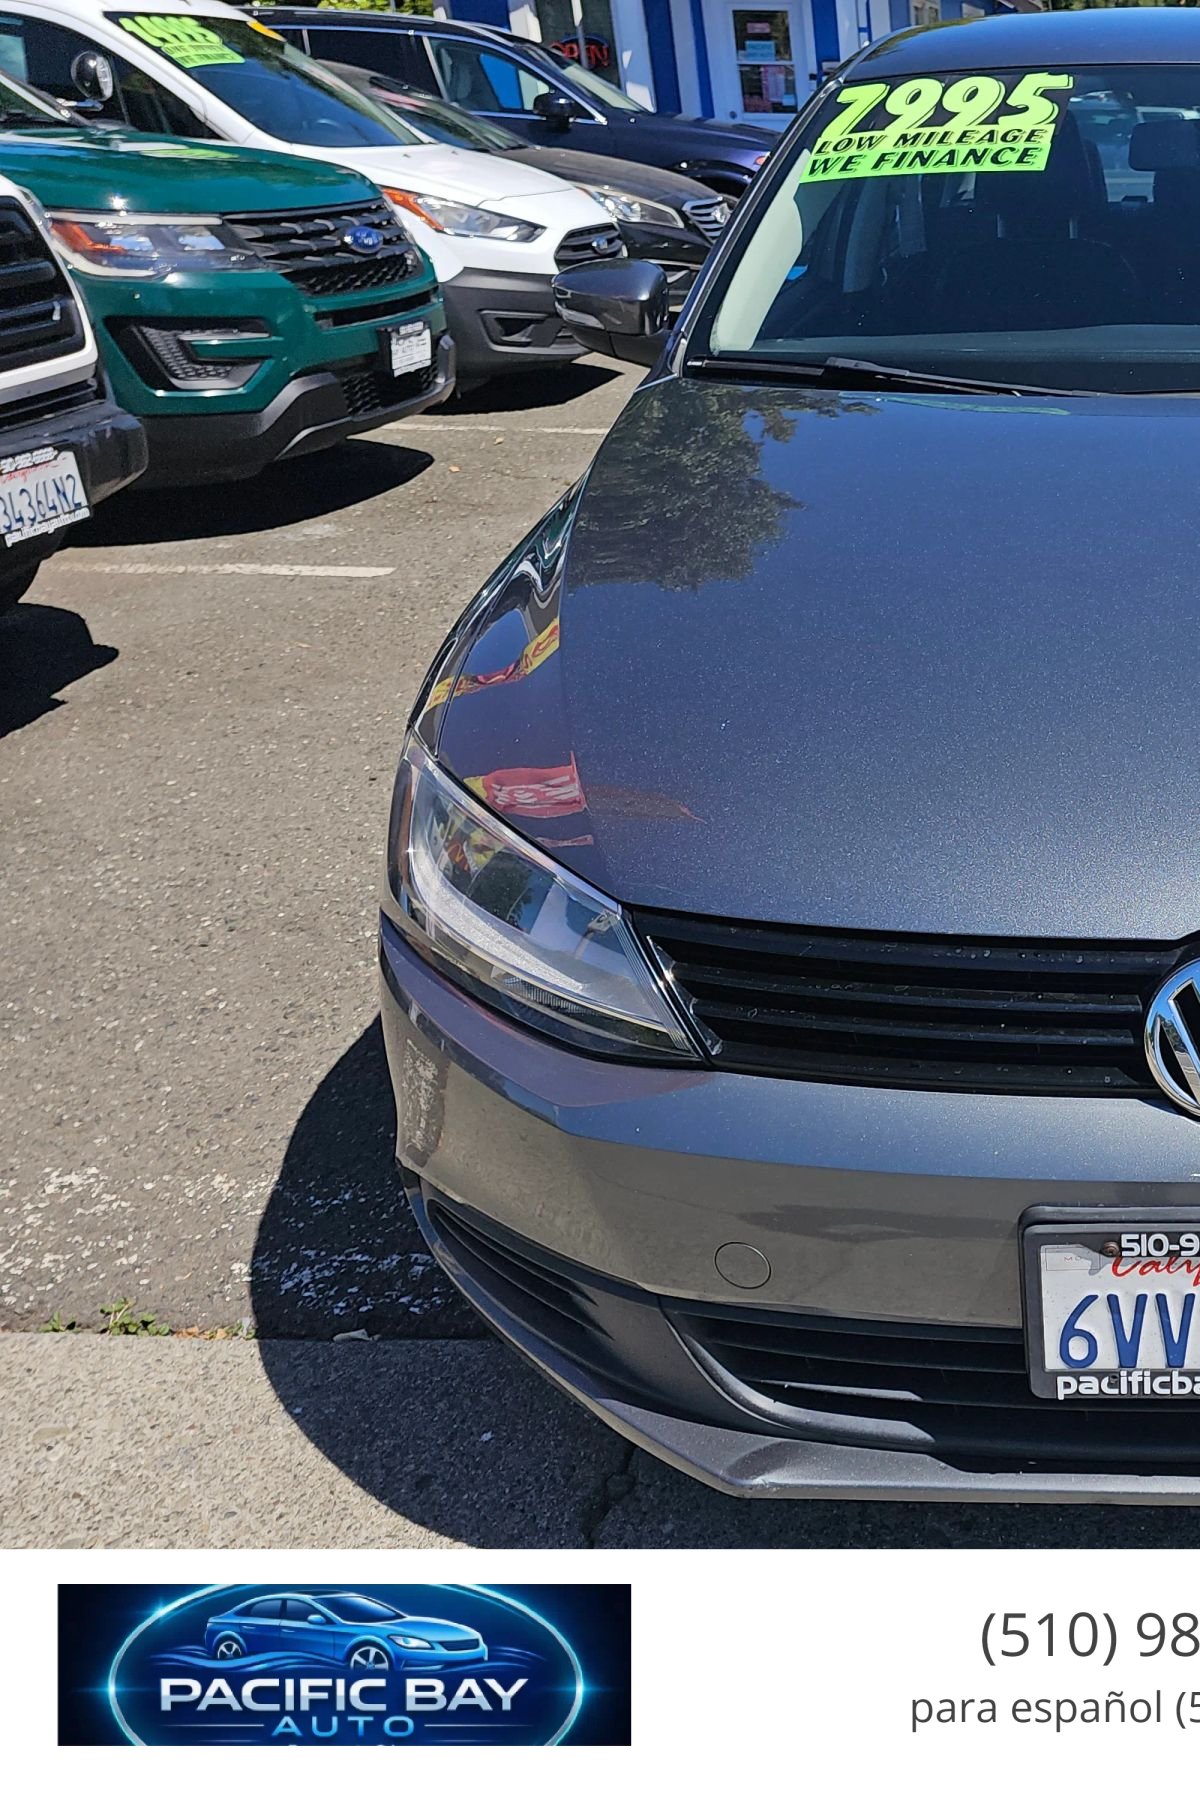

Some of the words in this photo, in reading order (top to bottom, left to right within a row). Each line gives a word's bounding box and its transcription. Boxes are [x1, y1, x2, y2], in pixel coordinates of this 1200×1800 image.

[548, 40, 609, 66] PN
[820, 72, 1074, 138] 7995
[816, 133, 888, 156] LOW
[892, 127, 1049, 149] MILEAGE
[808, 153, 867, 177] WE
[871, 146, 1040, 171] FINANCE
